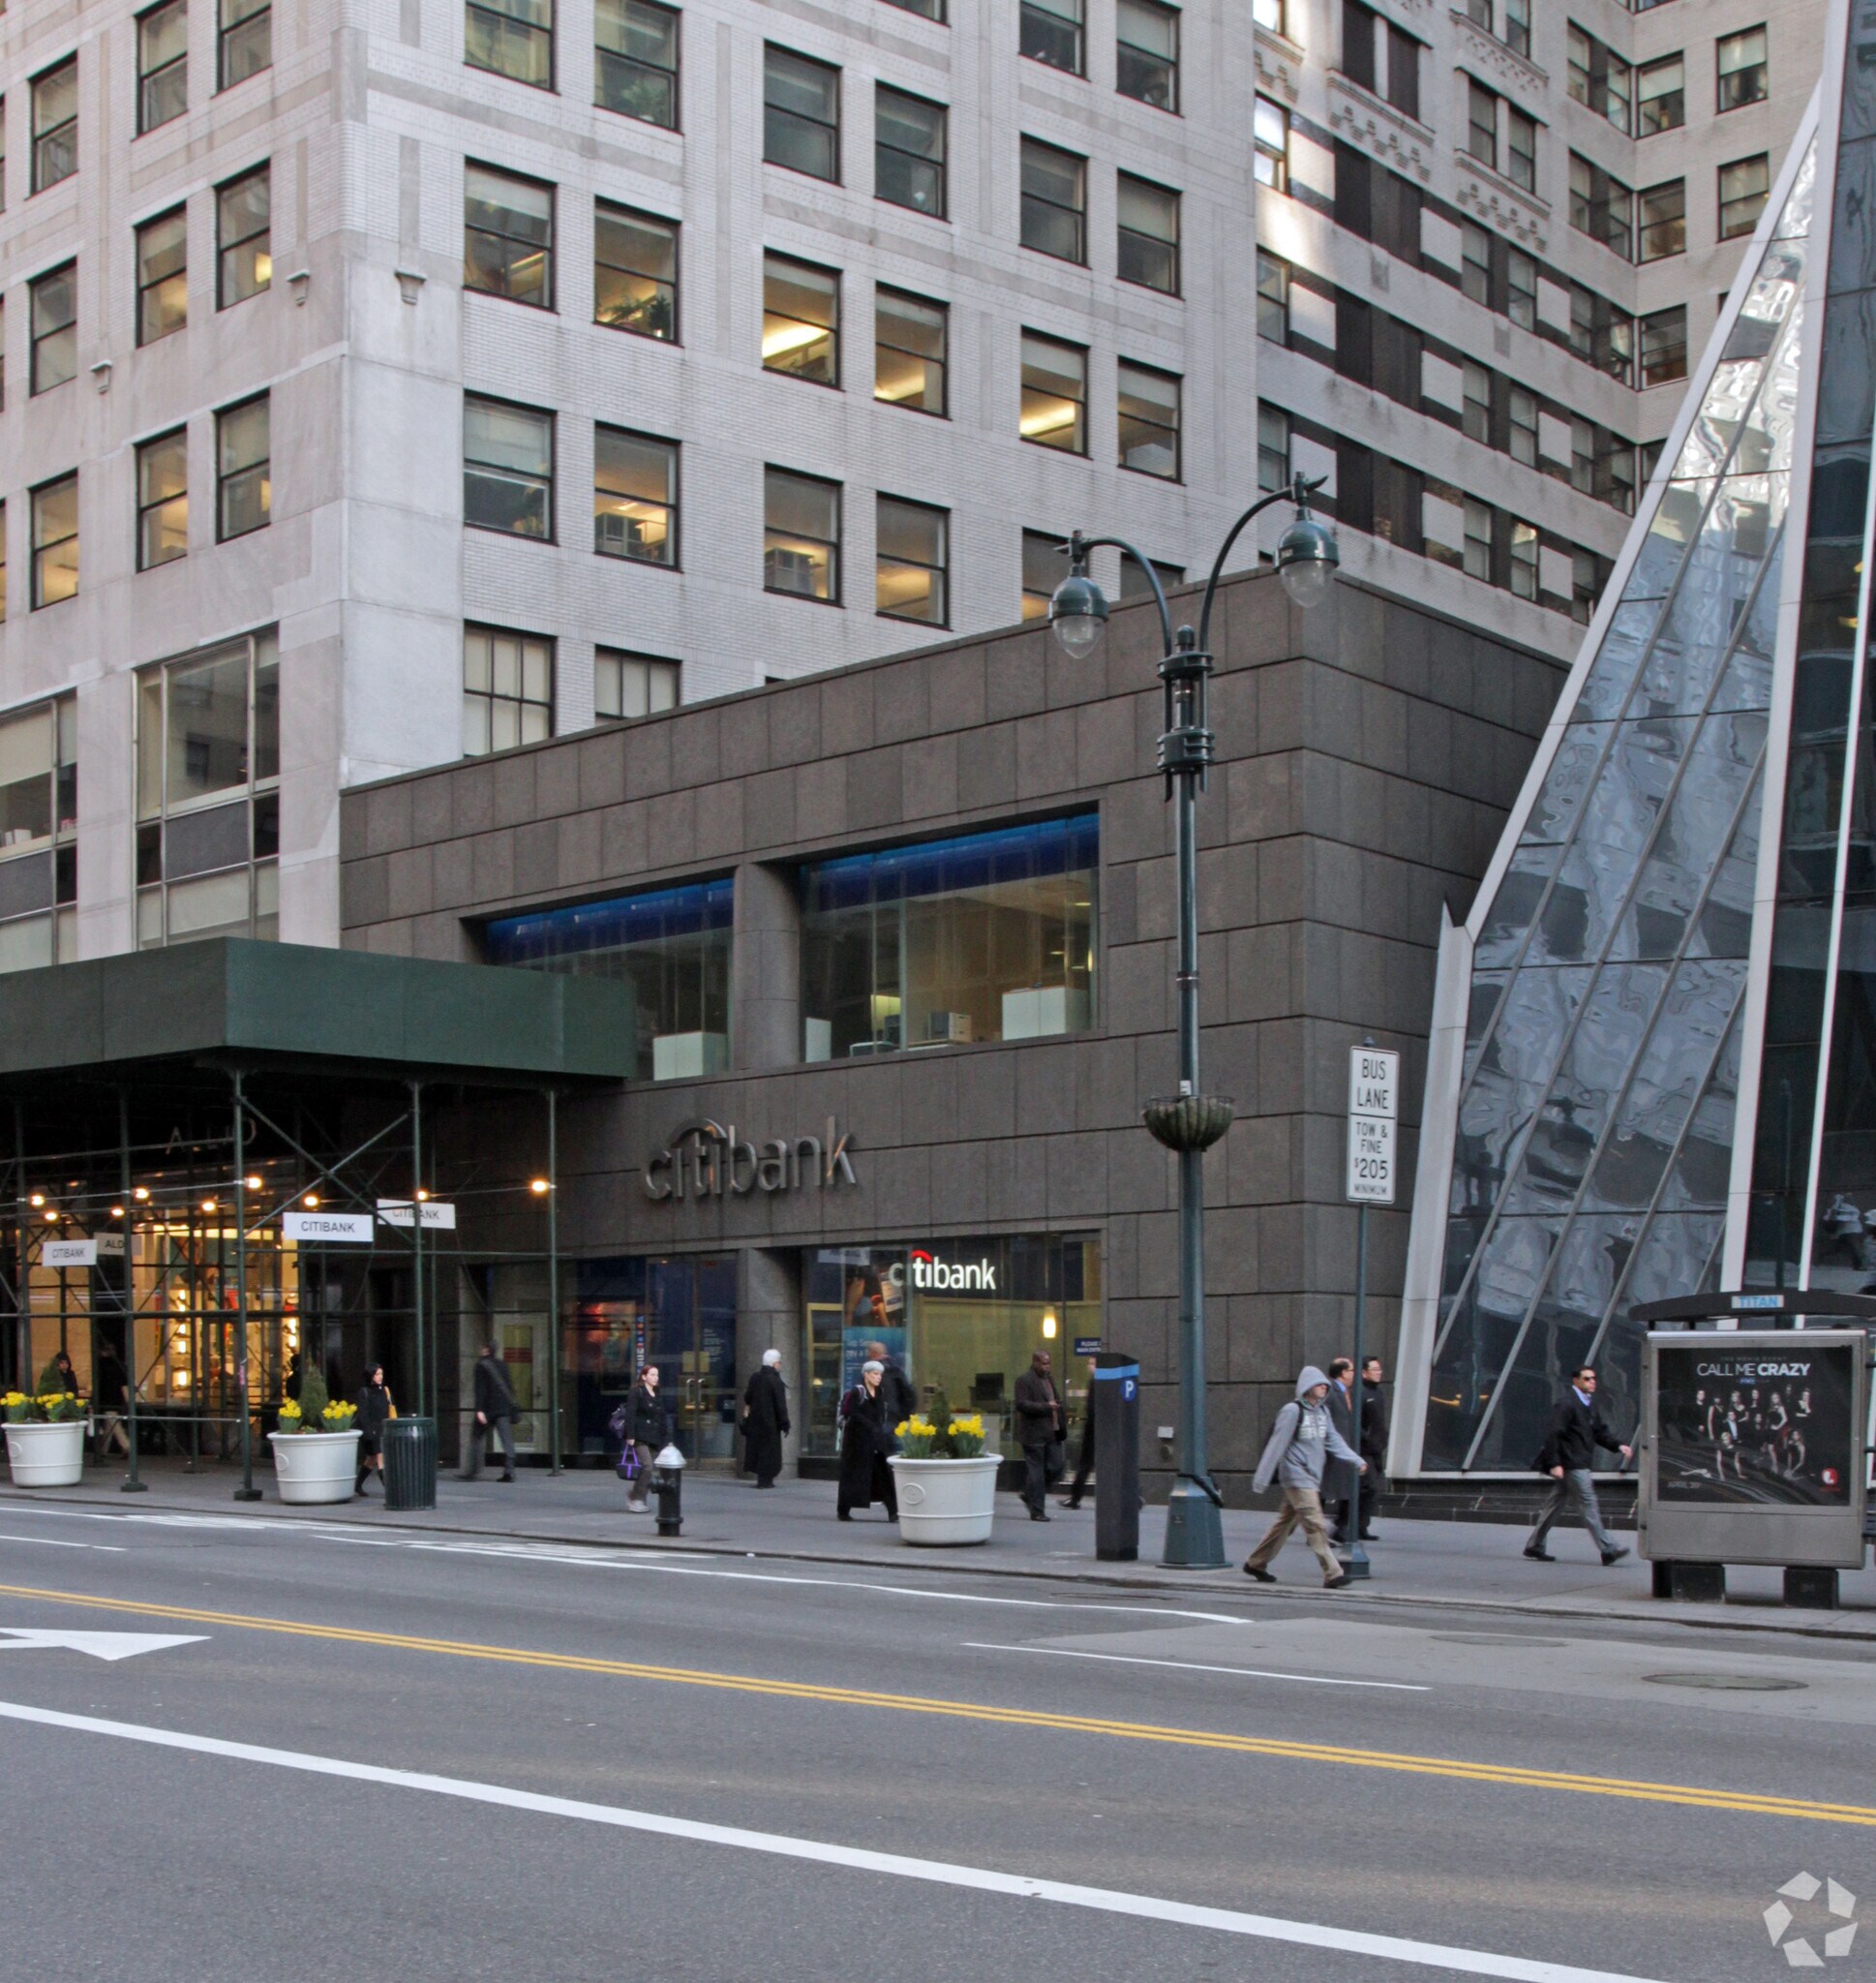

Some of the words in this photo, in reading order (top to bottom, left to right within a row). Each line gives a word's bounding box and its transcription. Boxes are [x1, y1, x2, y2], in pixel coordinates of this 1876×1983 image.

[1362, 1058, 1386, 1081] BUS
[1357, 1087, 1389, 1110] LANE
[1356, 1122, 1377, 1137] TOW
[1381, 1125, 1388, 1139] &
[1361, 1139, 1382, 1154] FINE
[640, 1115, 856, 1200] citibank
[1354, 1157, 1388, 1179] $205
[301, 1221, 355, 1234] CITIBANK
[52, 1248, 85, 1258] CITIBANK
[889, 1250, 996, 1290] citibank
[1739, 1296, 1778, 1308] TITAN
[1697, 1363, 1734, 1376] CALL
[1735, 1363, 1757, 1376] ME
[1757, 1363, 1811, 1376] CRAZY
[1126, 1380, 1135, 1398] P
